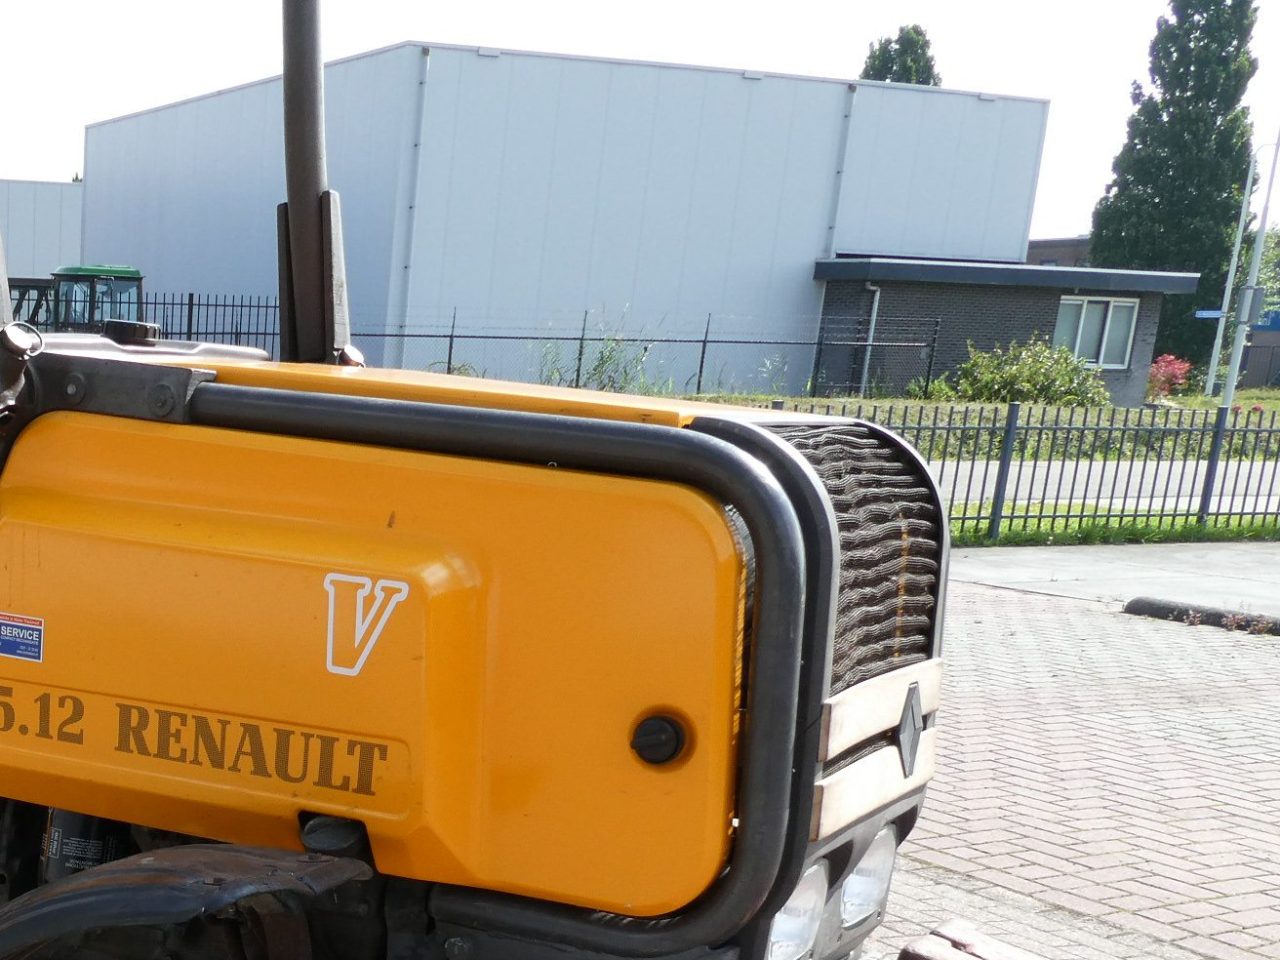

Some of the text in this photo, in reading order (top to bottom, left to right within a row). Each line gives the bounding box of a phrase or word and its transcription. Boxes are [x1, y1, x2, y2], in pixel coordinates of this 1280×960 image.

[0, 625, 40, 641] SERVICE
[324, 573, 409, 676] V
[114, 702, 389, 796] RENAULT
